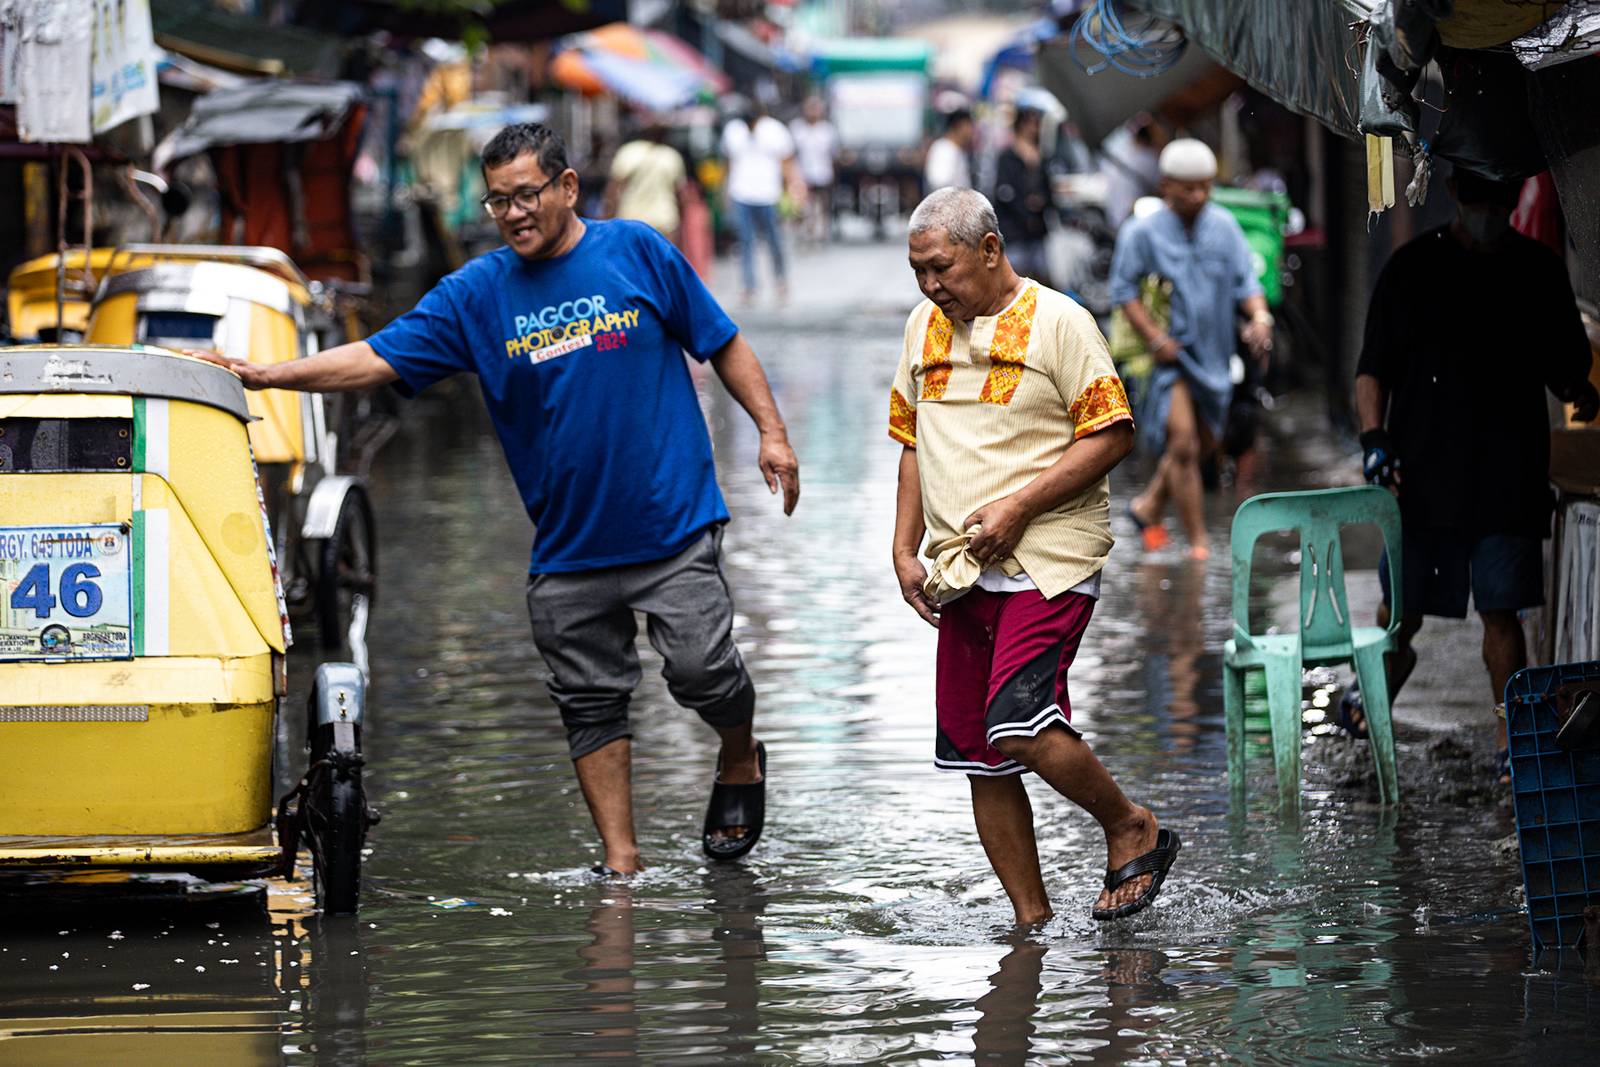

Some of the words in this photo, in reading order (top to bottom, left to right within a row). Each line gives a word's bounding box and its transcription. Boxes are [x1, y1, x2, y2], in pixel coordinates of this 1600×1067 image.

[505, 308, 639, 358] PHOTOGRAPHY
[514, 295, 608, 336] PAGCOR
[535, 337, 586, 361] Contest
[594, 330, 627, 352] 2024
[31, 533, 54, 559] 649
[57, 532, 93, 558] TODA
[10, 562, 103, 618] 46
